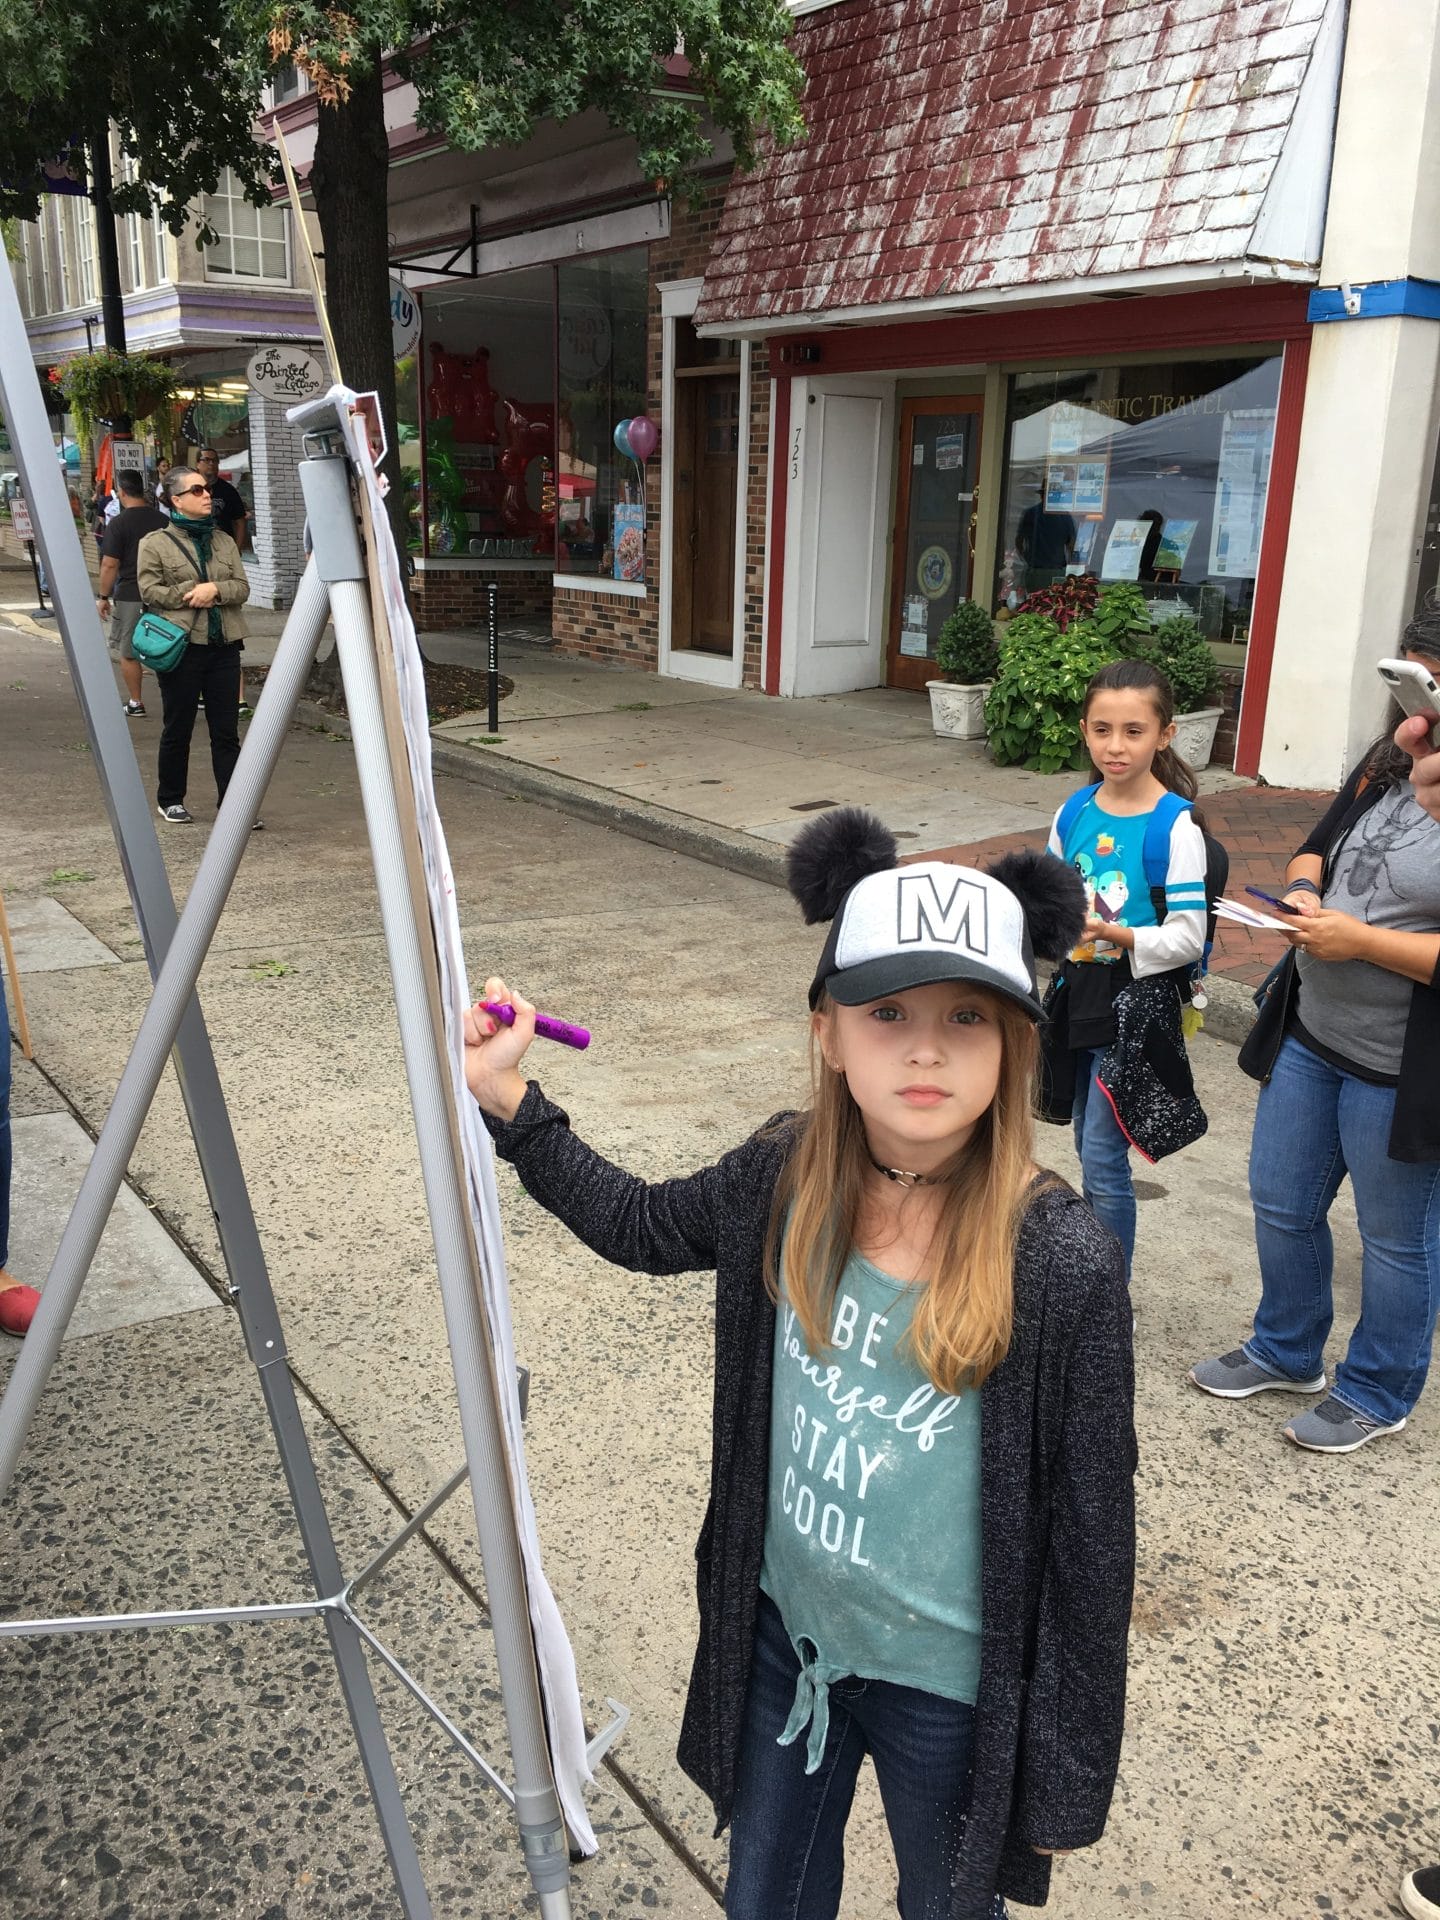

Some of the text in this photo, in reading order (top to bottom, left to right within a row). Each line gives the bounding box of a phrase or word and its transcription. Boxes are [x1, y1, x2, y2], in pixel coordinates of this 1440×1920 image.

[255, 360, 310, 381] Painted
[265, 348, 281, 361] The
[1147, 393, 1229, 417] TRAVEL
[117, 448, 140, 458] DO NOT
[119, 459, 139, 468] BLOCK
[791, 427, 802, 480] 723
[896, 873, 988, 957] M
[831, 1294, 889, 1369] BE
[791, 1404, 886, 1500] STAY
[782, 1465, 870, 1567] COOL
